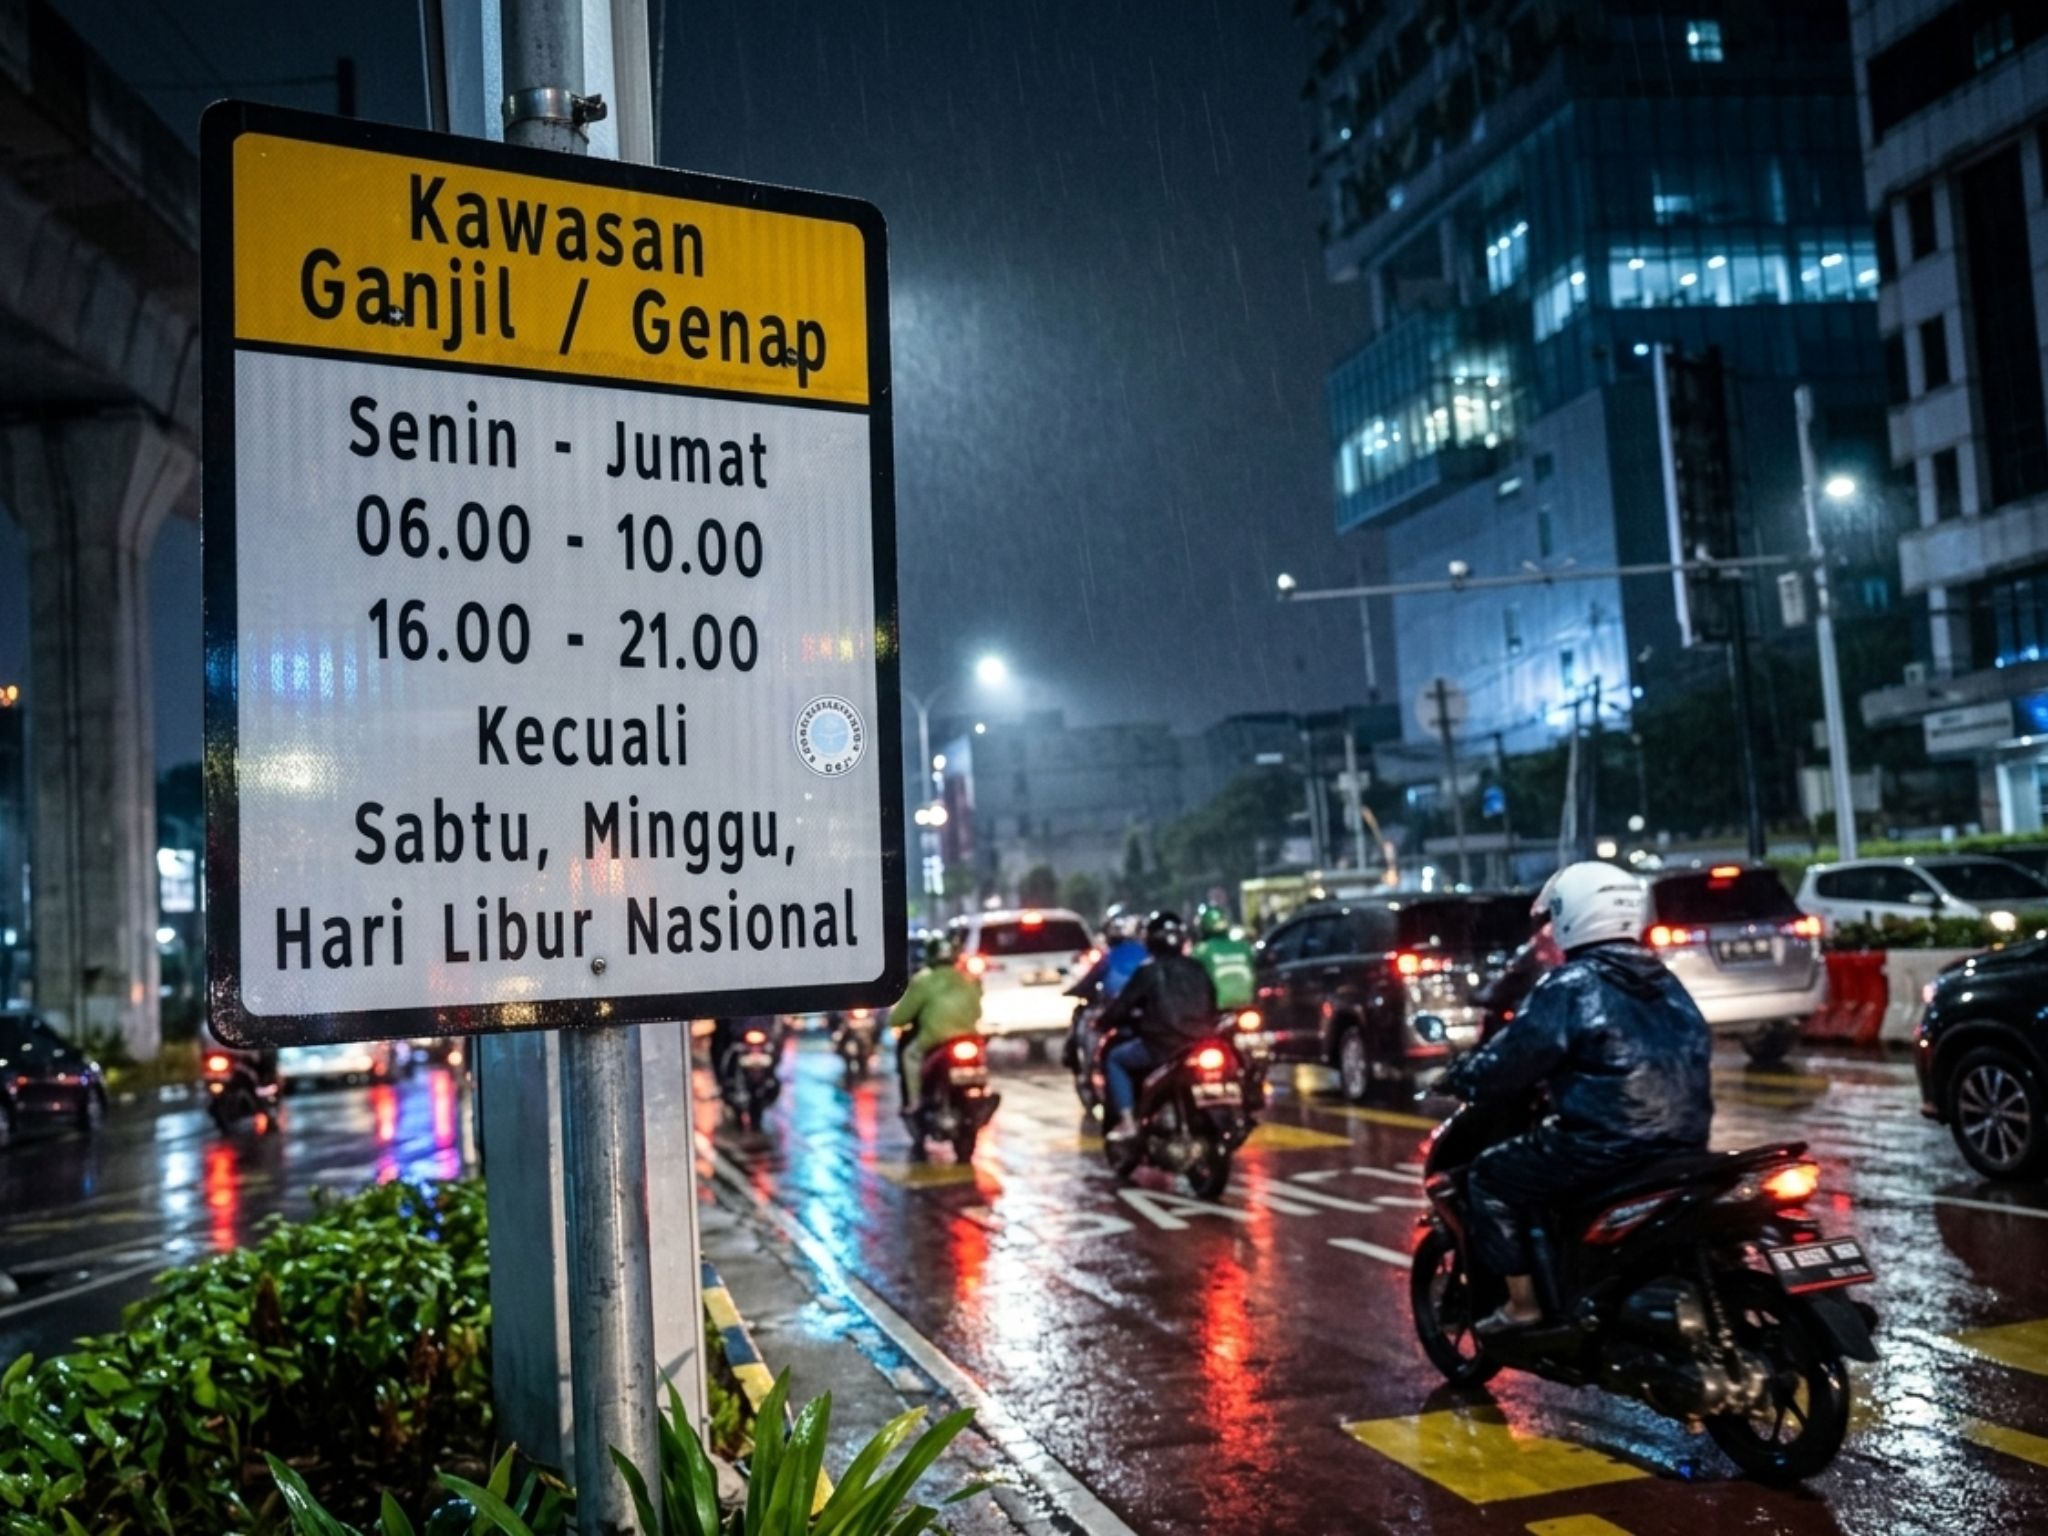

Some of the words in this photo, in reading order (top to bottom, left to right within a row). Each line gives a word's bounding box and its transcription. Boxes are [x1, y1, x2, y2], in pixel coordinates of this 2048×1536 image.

[410, 173, 703, 276] Kawasan
[300, 248, 515, 351] Ganjil
[559, 278, 588, 355] /
[632, 289, 826, 388] Genap
[349, 395, 517, 468] Senin
[555, 440, 571, 454] -
[606, 420, 767, 488] Jumat
[356, 494, 530, 564] 06.00
[567, 535, 583, 548] -
[617, 513, 763, 578] 10.00
[368, 598, 530, 665] 16.00
[567, 633, 584, 647] -
[619, 609, 758, 672] 21.00
[478, 703, 687, 767] Kecuali
[355, 797, 548, 871] Sabtu,
[584, 794, 796, 875] Minggu,
[276, 897, 403, 970] Hari
[444, 895, 593, 963] Libur
[627, 888, 858, 955] Nasional
